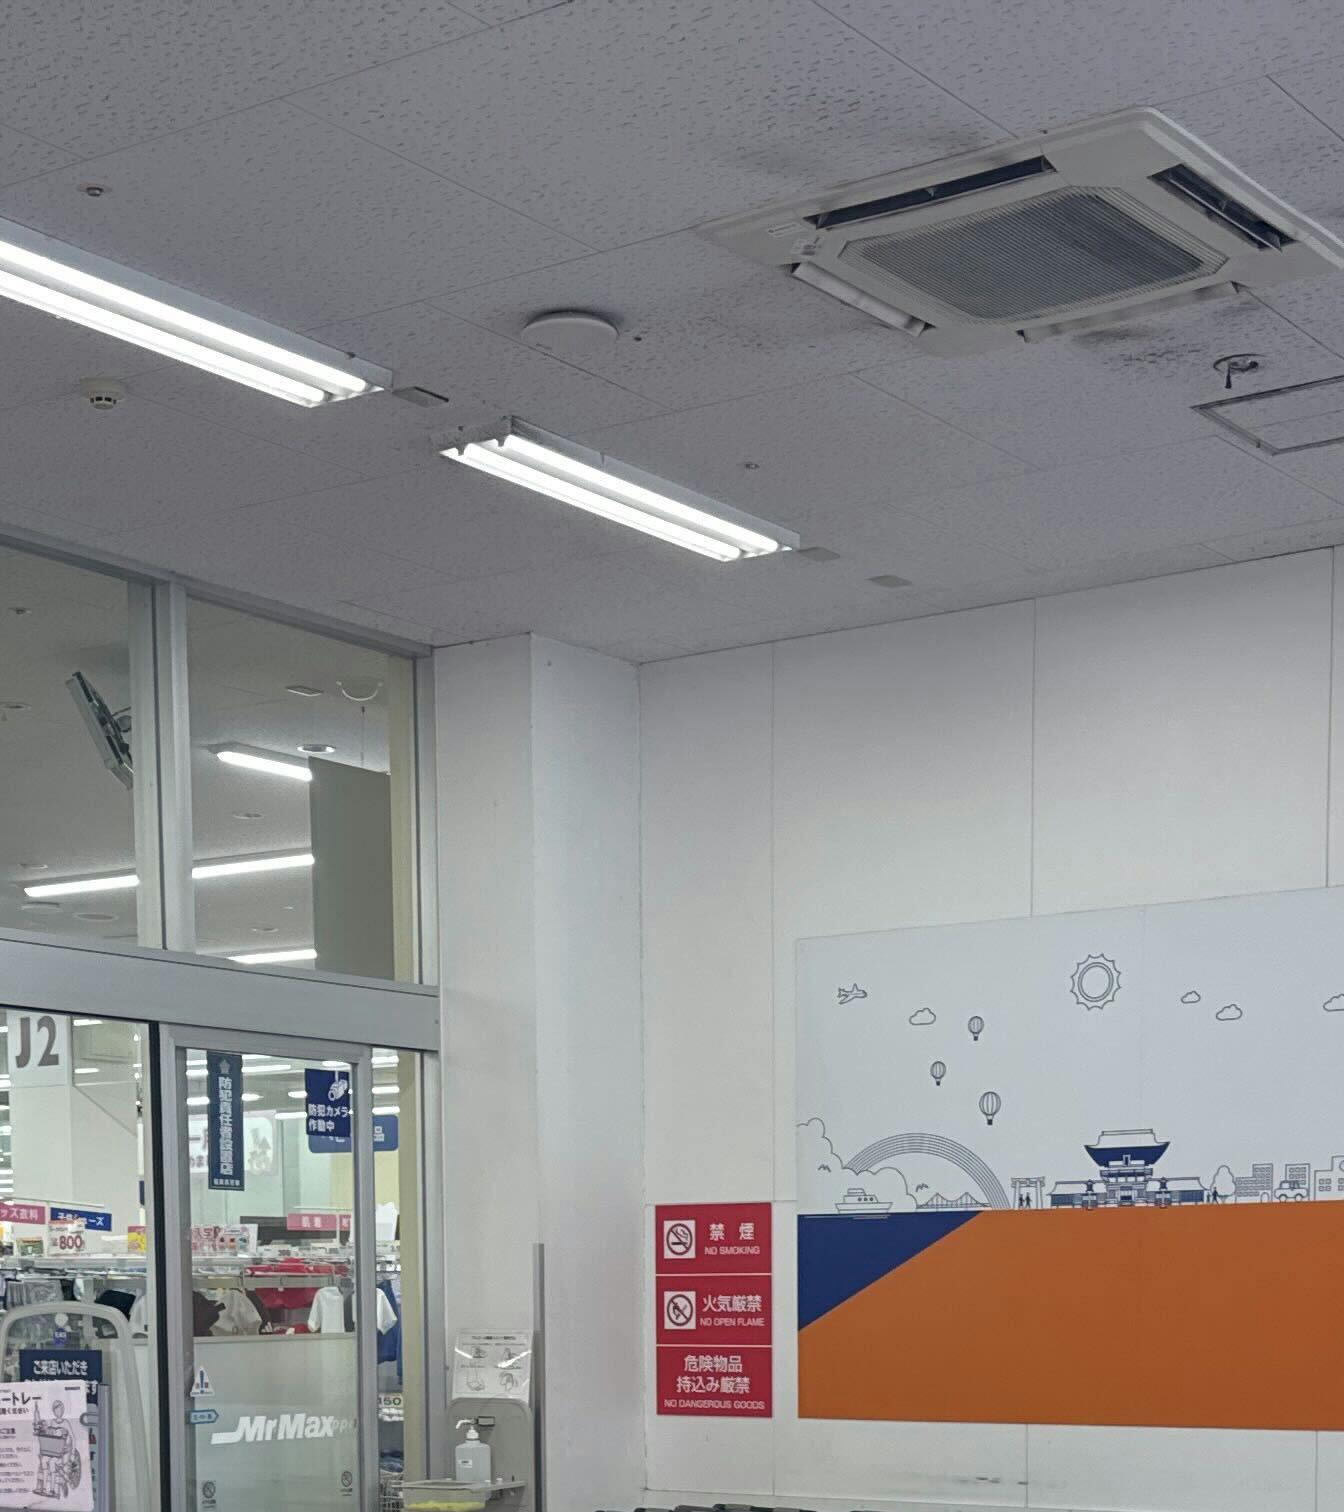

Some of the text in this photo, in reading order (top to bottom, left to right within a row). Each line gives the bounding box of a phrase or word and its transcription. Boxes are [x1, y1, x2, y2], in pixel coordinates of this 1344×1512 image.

[15, 1015, 59, 1068] J2
[308, 1103, 349, 1118] 防犯カメラ
[719, 1246, 760, 1255] SMOKING
[702, 1295, 762, 1312] 火気厳禁
[714, 1317, 736, 1327] OPEN
[737, 1317, 765, 1327] FLAME
[683, 1355, 743, 1373] 危険物品
[676, 1376, 750, 1394] 持込み厳禁
[678, 1399, 732, 1409] DANGEROUS
[733, 1400, 765, 1410] GOODS
[210, 1413, 335, 1444] MrMax
